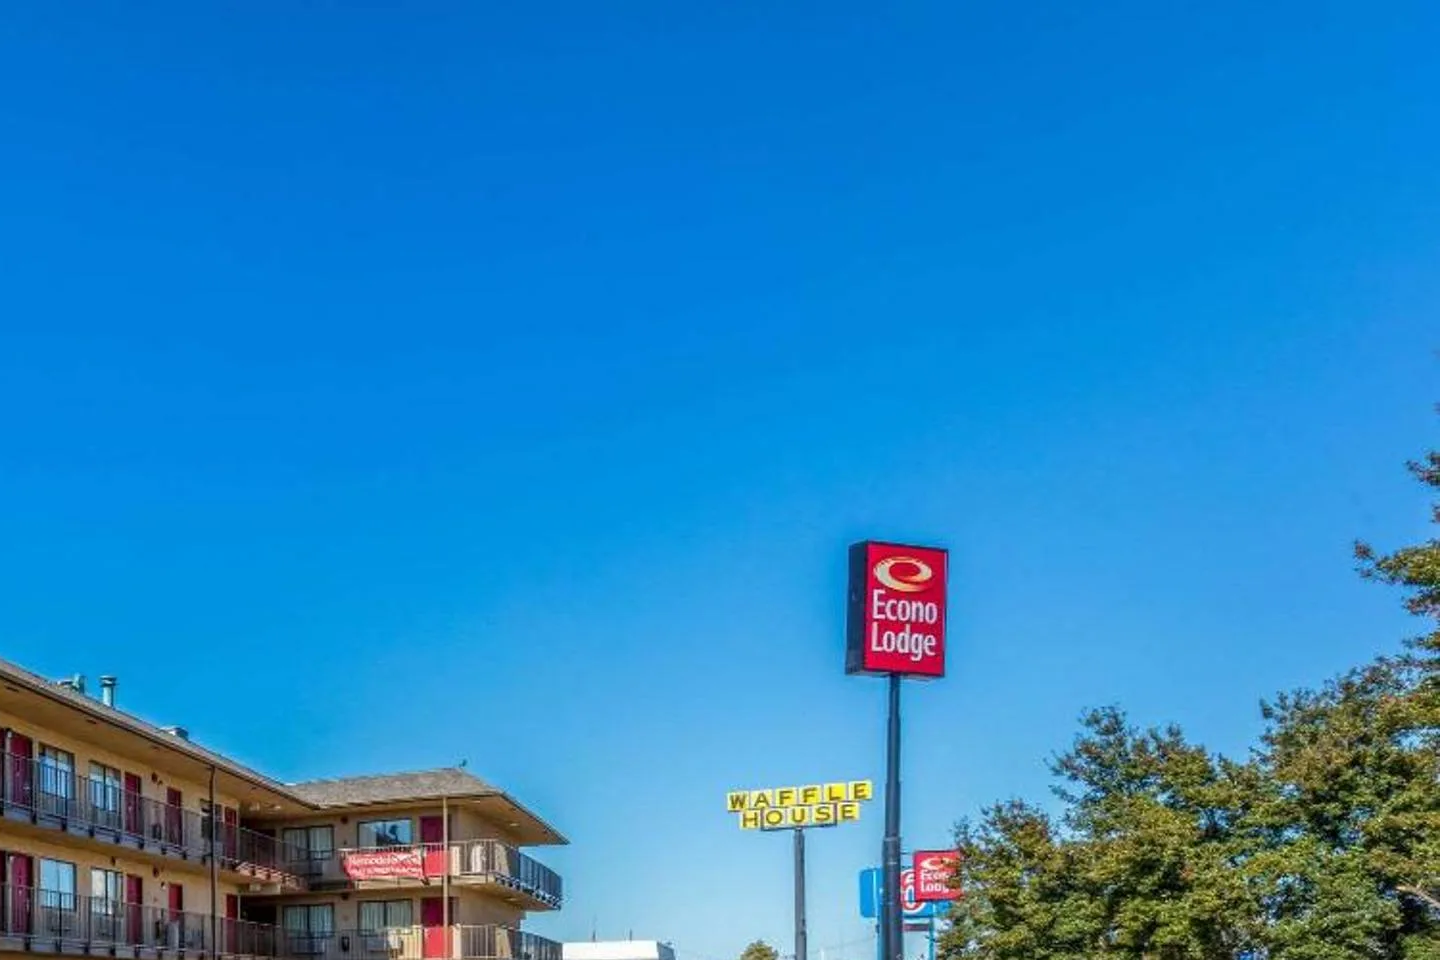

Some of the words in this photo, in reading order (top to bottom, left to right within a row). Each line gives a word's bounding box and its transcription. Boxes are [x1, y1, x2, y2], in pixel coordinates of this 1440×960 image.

[872, 588, 938, 625] Econo
[871, 621, 937, 662] Lodge
[729, 782, 868, 809] WAFFLE
[742, 804, 857, 828] HOUSE
